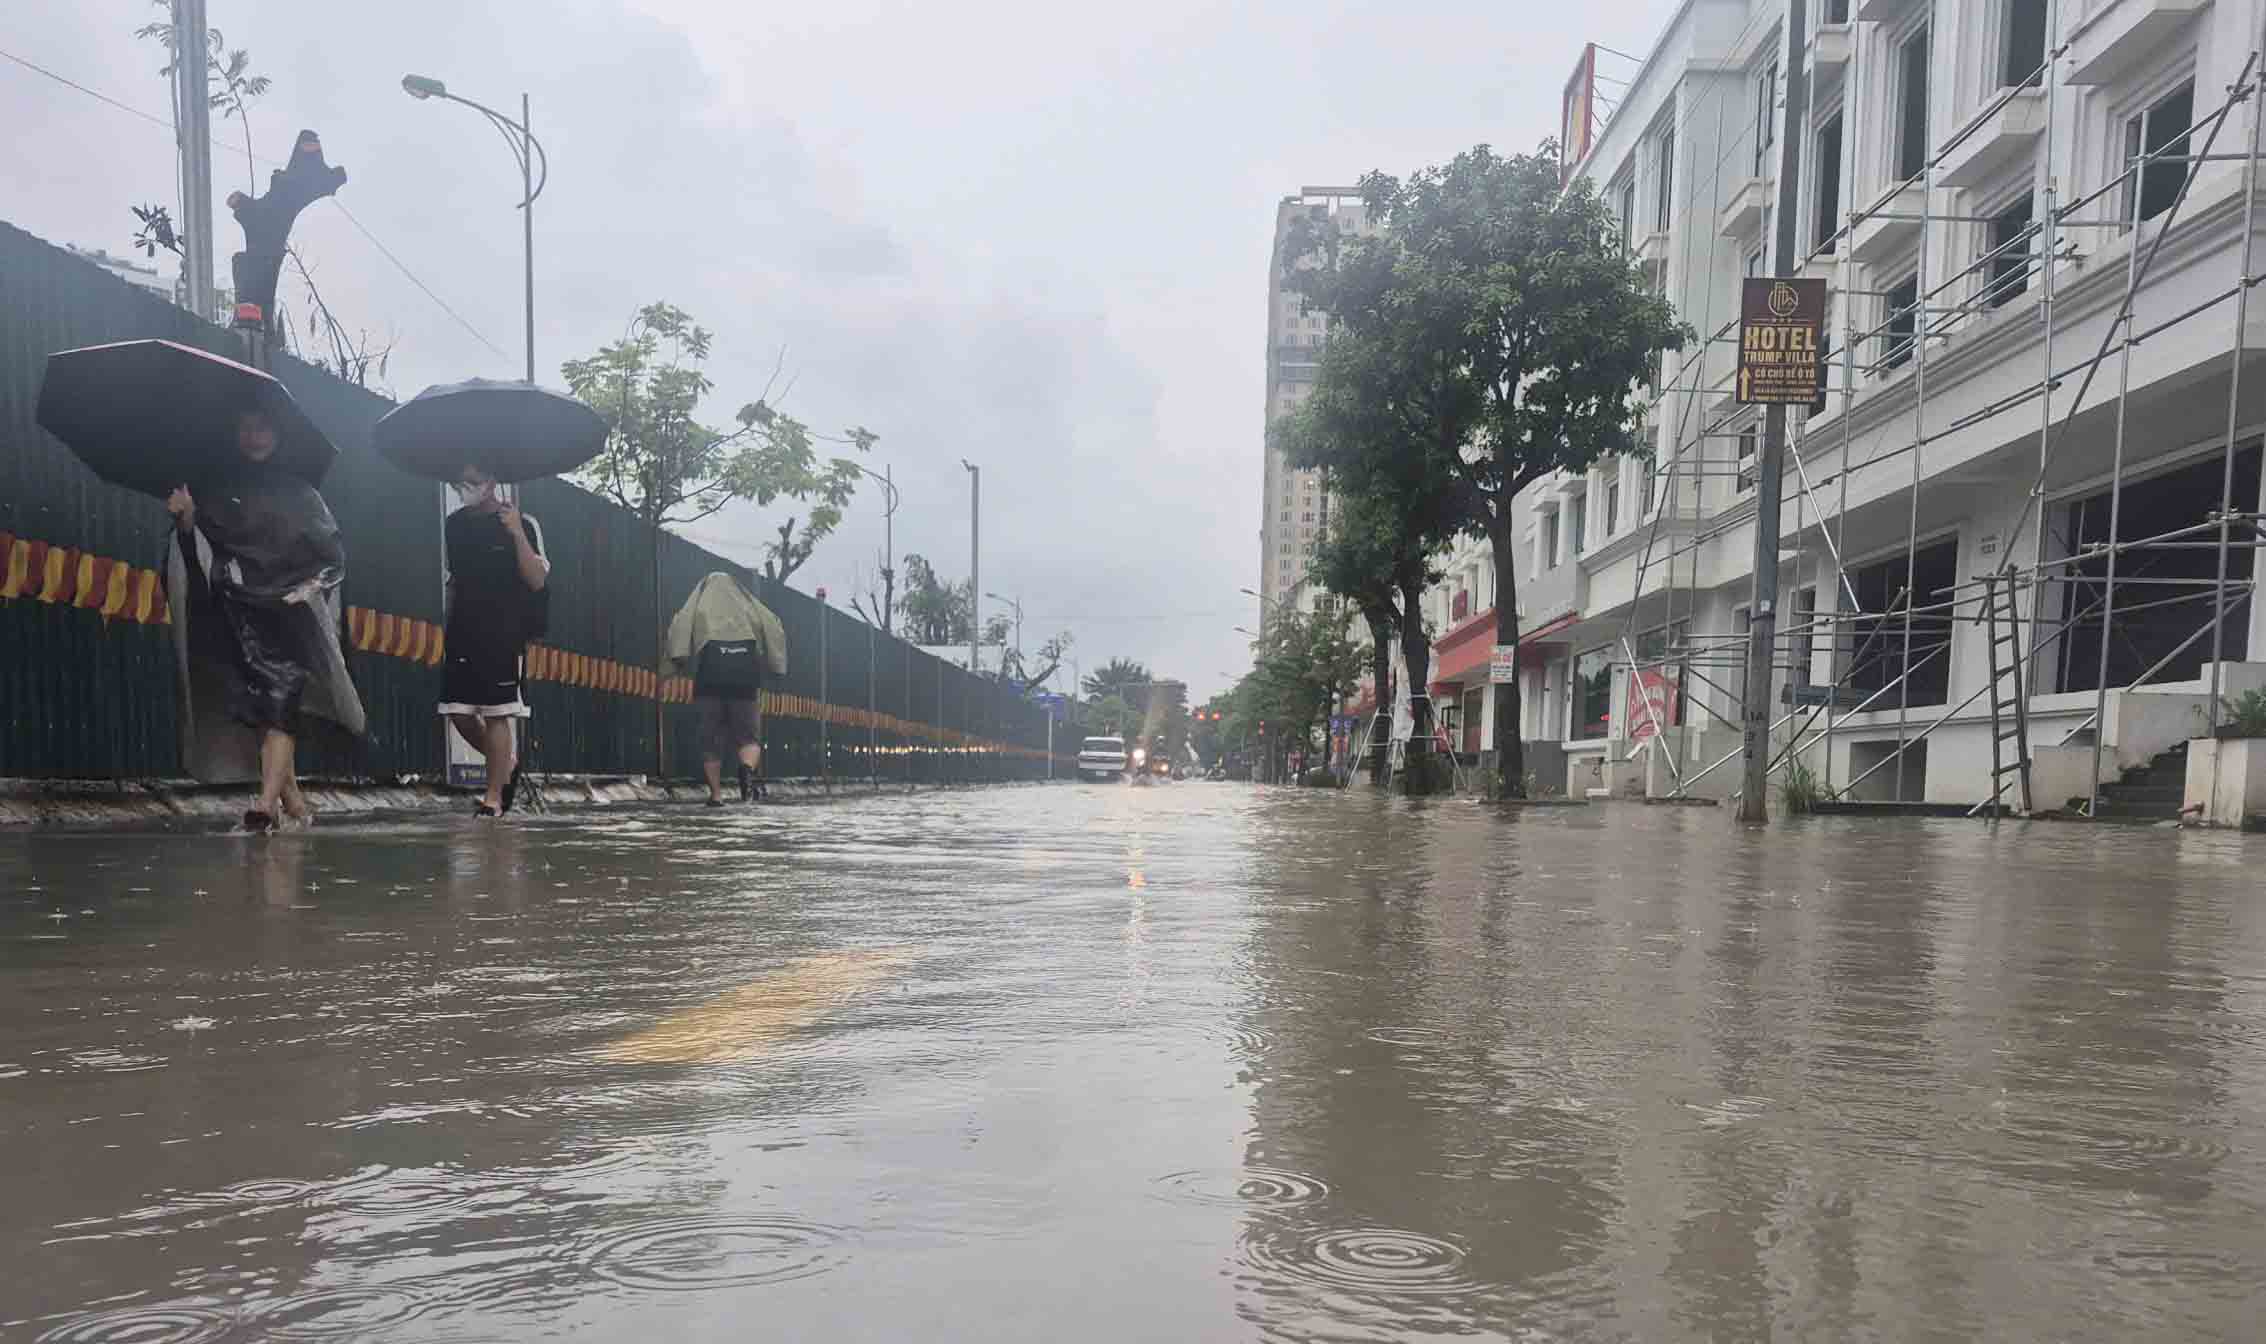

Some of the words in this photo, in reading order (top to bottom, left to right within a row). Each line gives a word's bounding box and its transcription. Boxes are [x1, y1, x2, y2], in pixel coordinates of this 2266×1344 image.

[1744, 326, 1817, 350] HOTEL
[1744, 351, 1783, 363] TRUMP
[1785, 351, 1815, 363] VILLA
